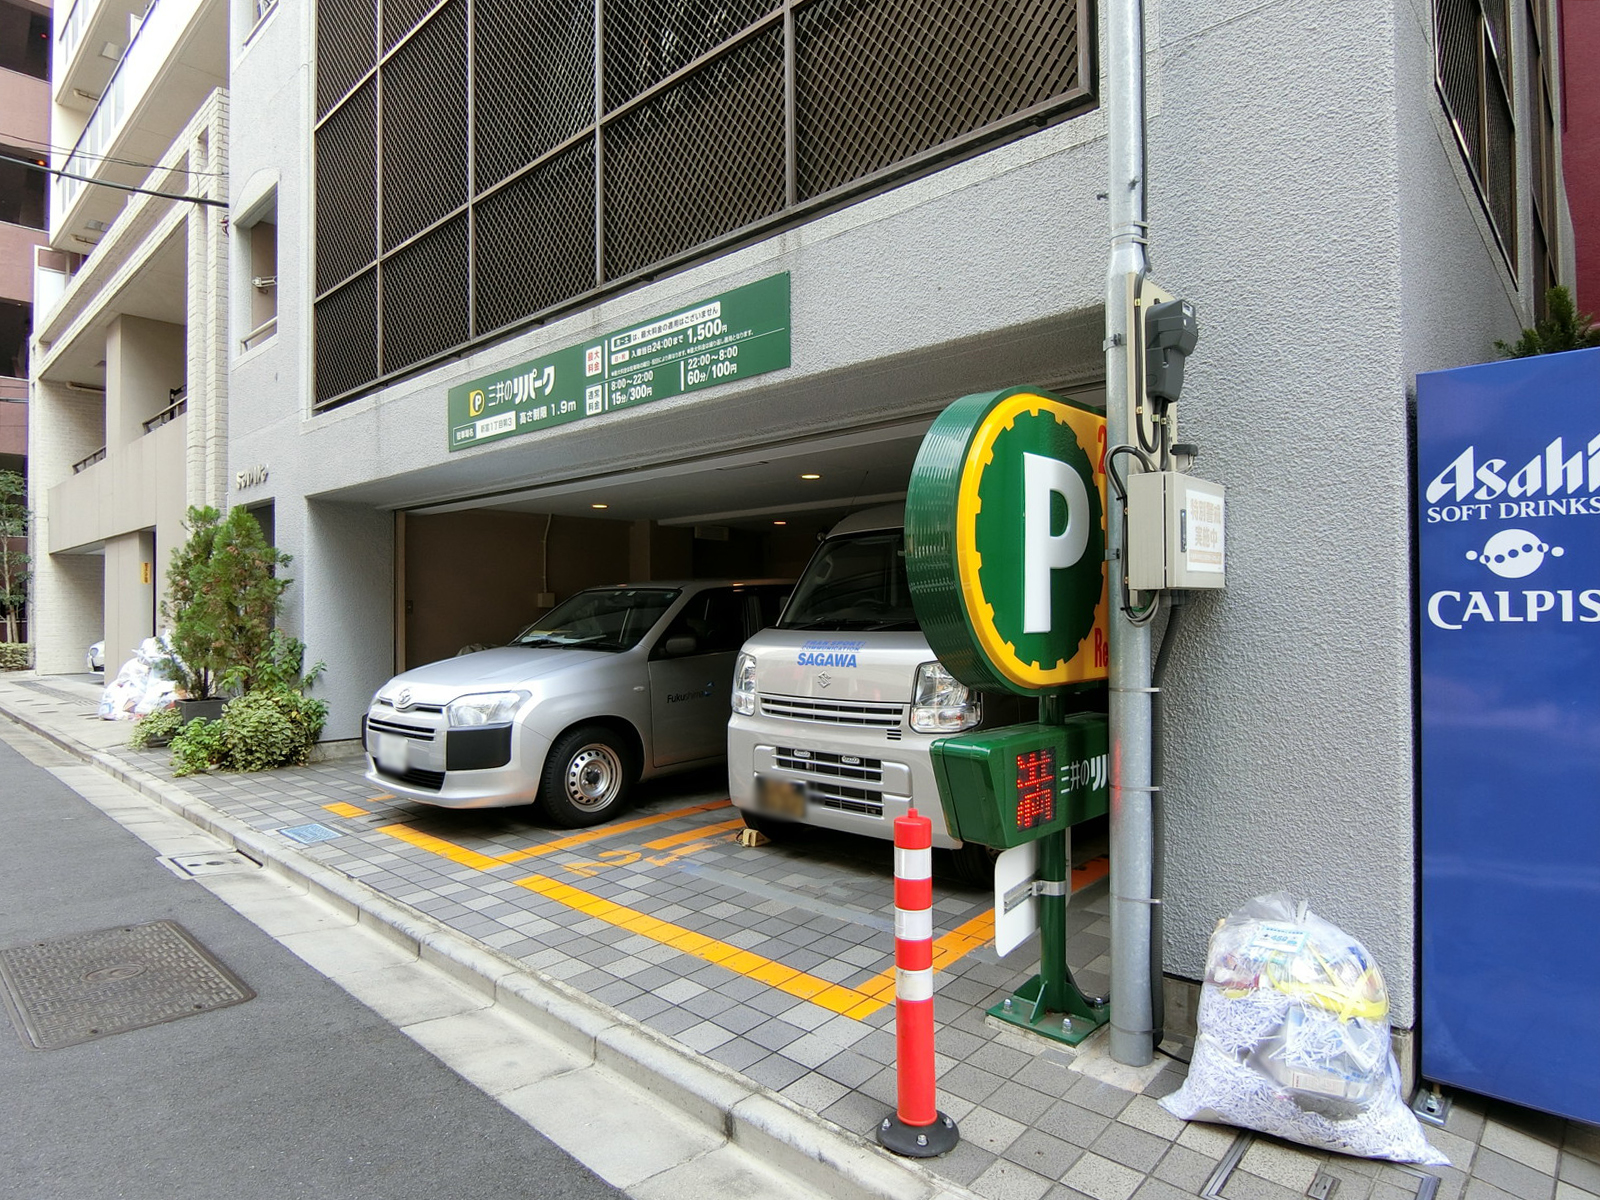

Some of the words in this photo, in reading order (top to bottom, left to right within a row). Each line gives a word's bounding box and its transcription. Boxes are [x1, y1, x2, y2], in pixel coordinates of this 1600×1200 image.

[687, 318, 728, 344] 1,500円
[488, 366, 556, 407] 三井のリパーク
[519, 406, 548, 425] 高さ制限
[551, 400, 577, 416] 1.9m
[1426, 433, 1600, 504] Asahi
[1427, 504, 1492, 523] SOFT
[1499, 497, 1600, 519] DRINKS
[1023, 452, 1090, 634] P
[1427, 589, 1600, 630] CALPIS
[797, 653, 857, 668] SAGAWA
